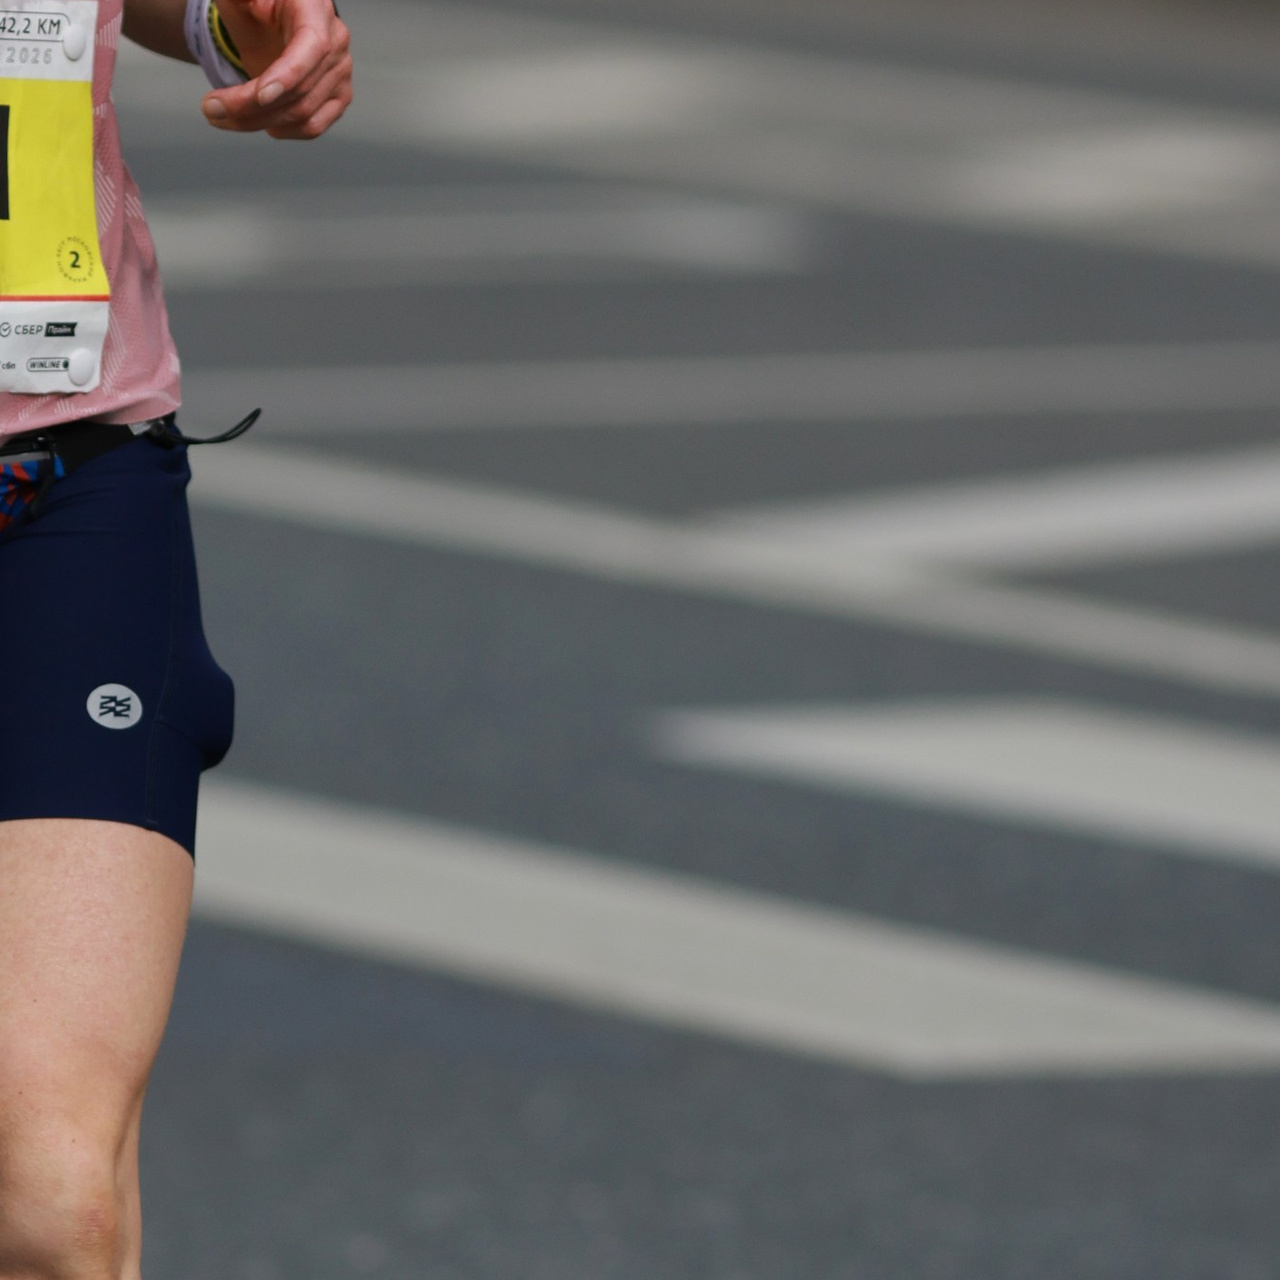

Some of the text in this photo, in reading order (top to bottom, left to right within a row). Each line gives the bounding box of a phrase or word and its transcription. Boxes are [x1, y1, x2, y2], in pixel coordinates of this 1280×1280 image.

[37, 19, 61, 35] КМ
[5, 47, 53, 64] 2026
[69, 250, 81, 269] 2
[14, 324, 43, 335] СБЕР
